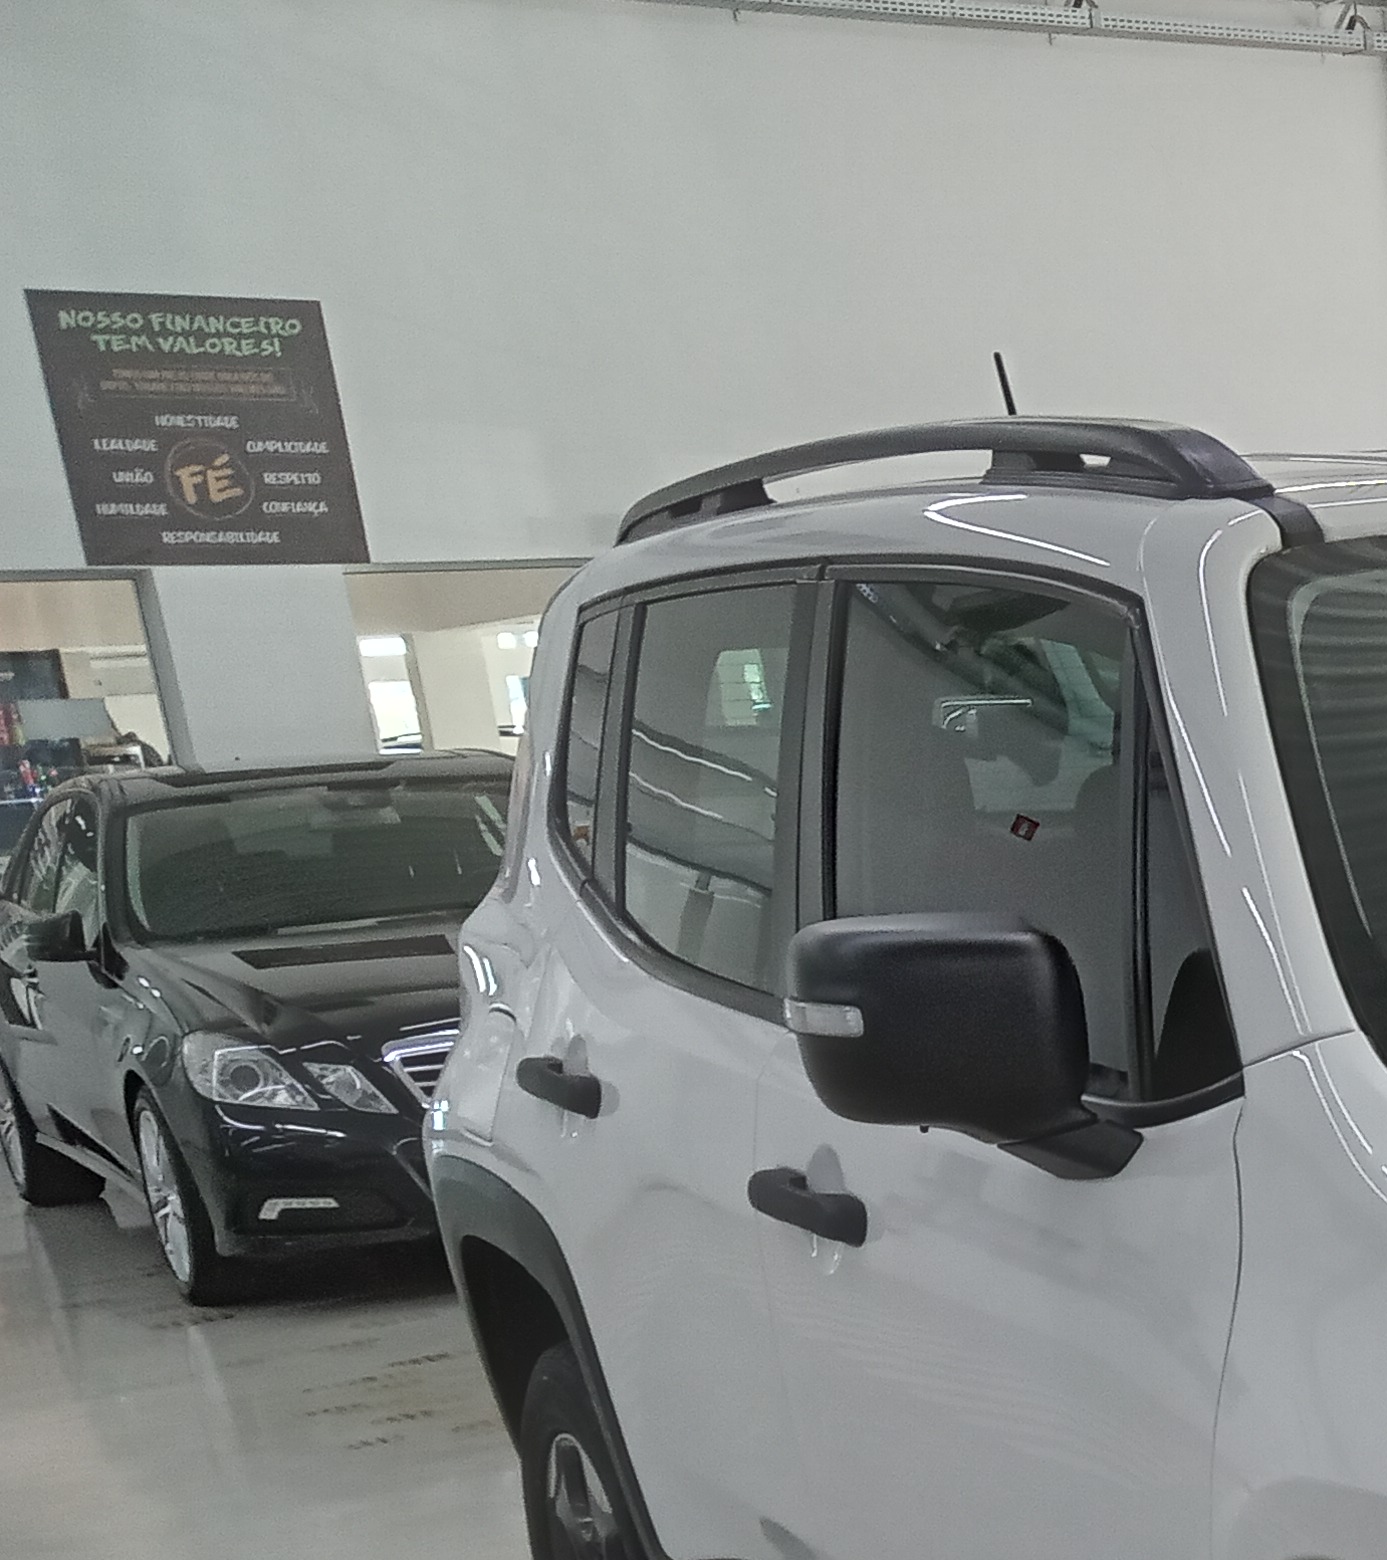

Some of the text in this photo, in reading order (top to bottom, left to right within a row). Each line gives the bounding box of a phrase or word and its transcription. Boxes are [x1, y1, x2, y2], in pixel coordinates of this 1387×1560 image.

[58, 309, 302, 337] NOSSO FINANCEIRO
[91, 333, 283, 358] TEM VALORES!
[155, 414, 239, 430] HONESTIDADE
[93, 438, 159, 452] LEALDADE
[112, 467, 154, 484] UNIÃO
[174, 453, 245, 505] FÉ
[262, 471, 321, 486] RESPEITO
[262, 501, 328, 517] CONFIANÇA
[160, 530, 281, 545] RESPONSABILIDADE
